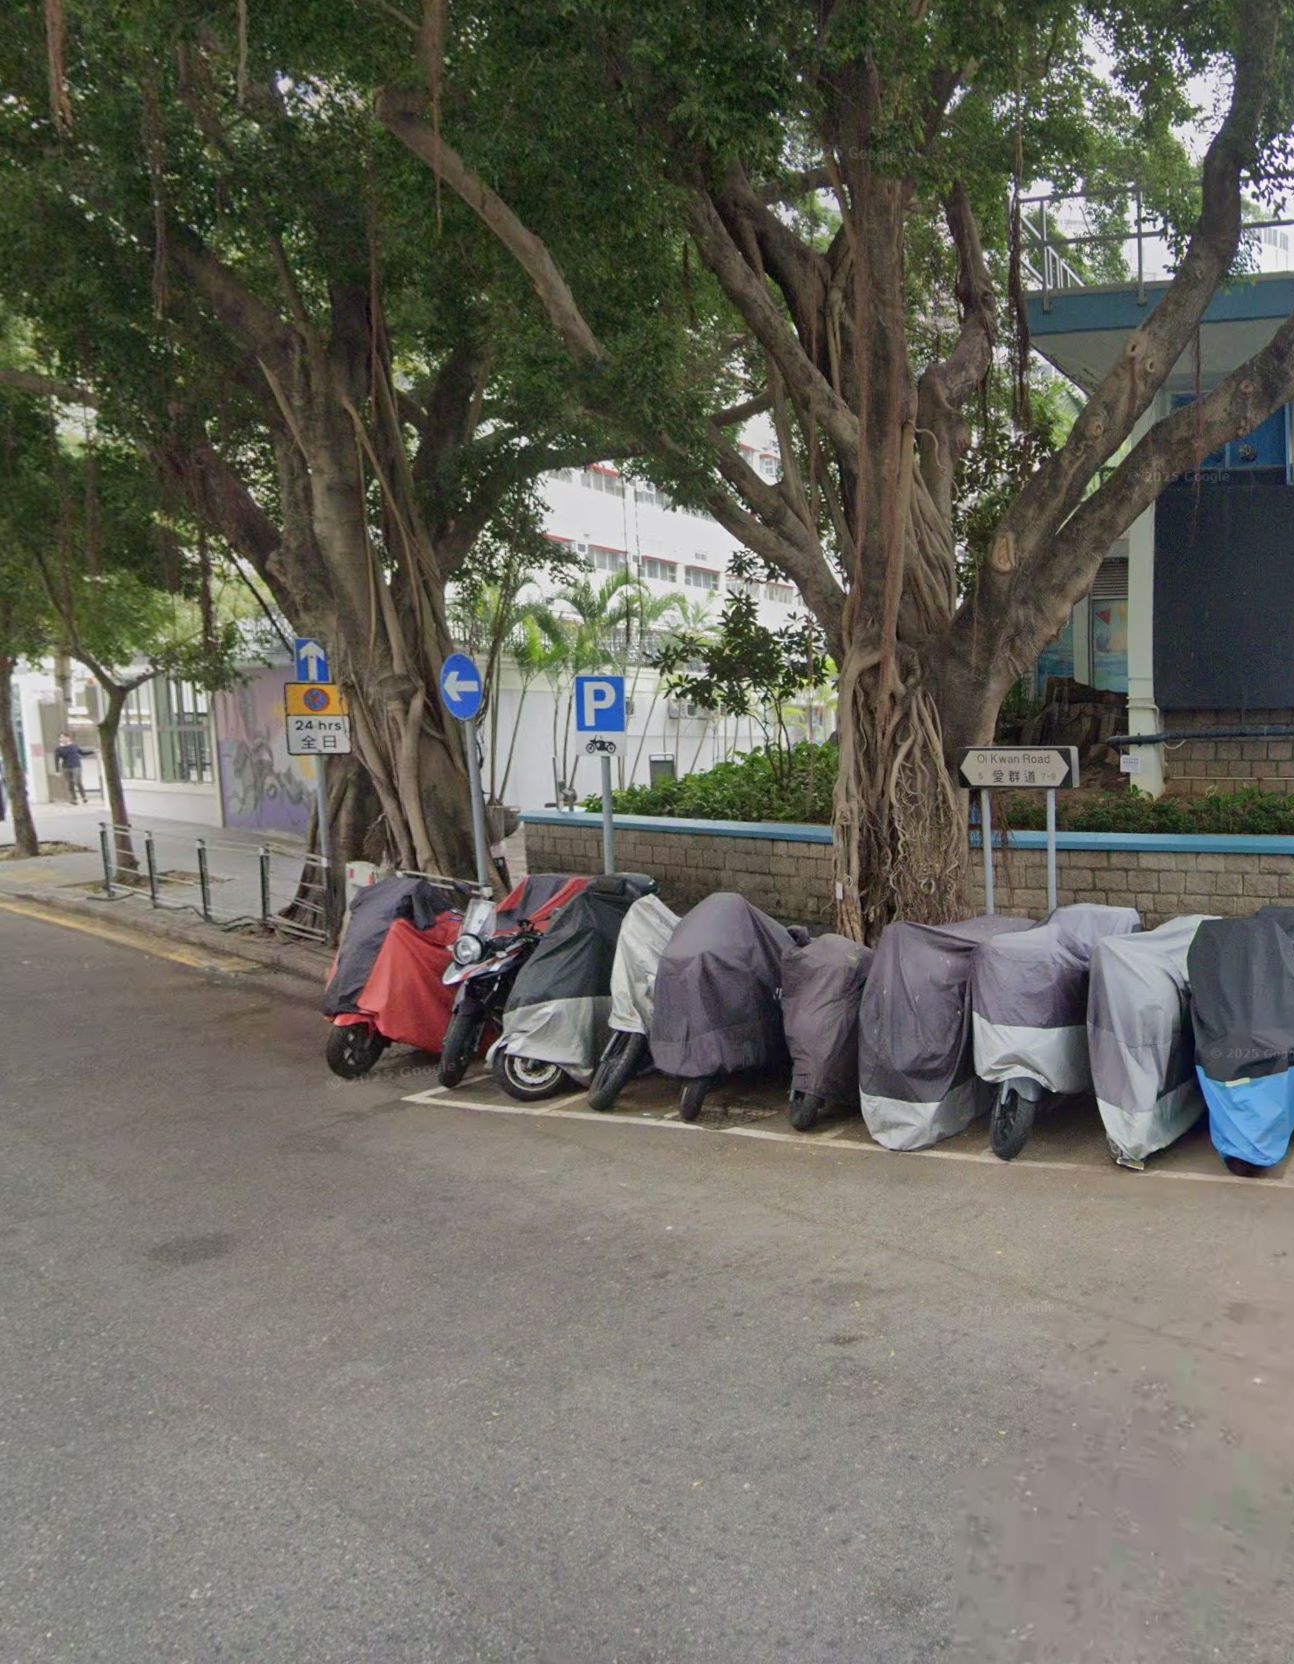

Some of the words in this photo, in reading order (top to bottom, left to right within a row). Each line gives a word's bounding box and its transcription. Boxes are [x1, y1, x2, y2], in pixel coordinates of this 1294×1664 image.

[583, 681, 616, 728] P
[295, 720, 314, 731] 24
[318, 720, 342, 731] hrs
[300, 734, 337, 750] 全日
[976, 753, 988, 764] Oi
[990, 754, 1020, 764] Kwan
[1022, 753, 1050, 764] Road
